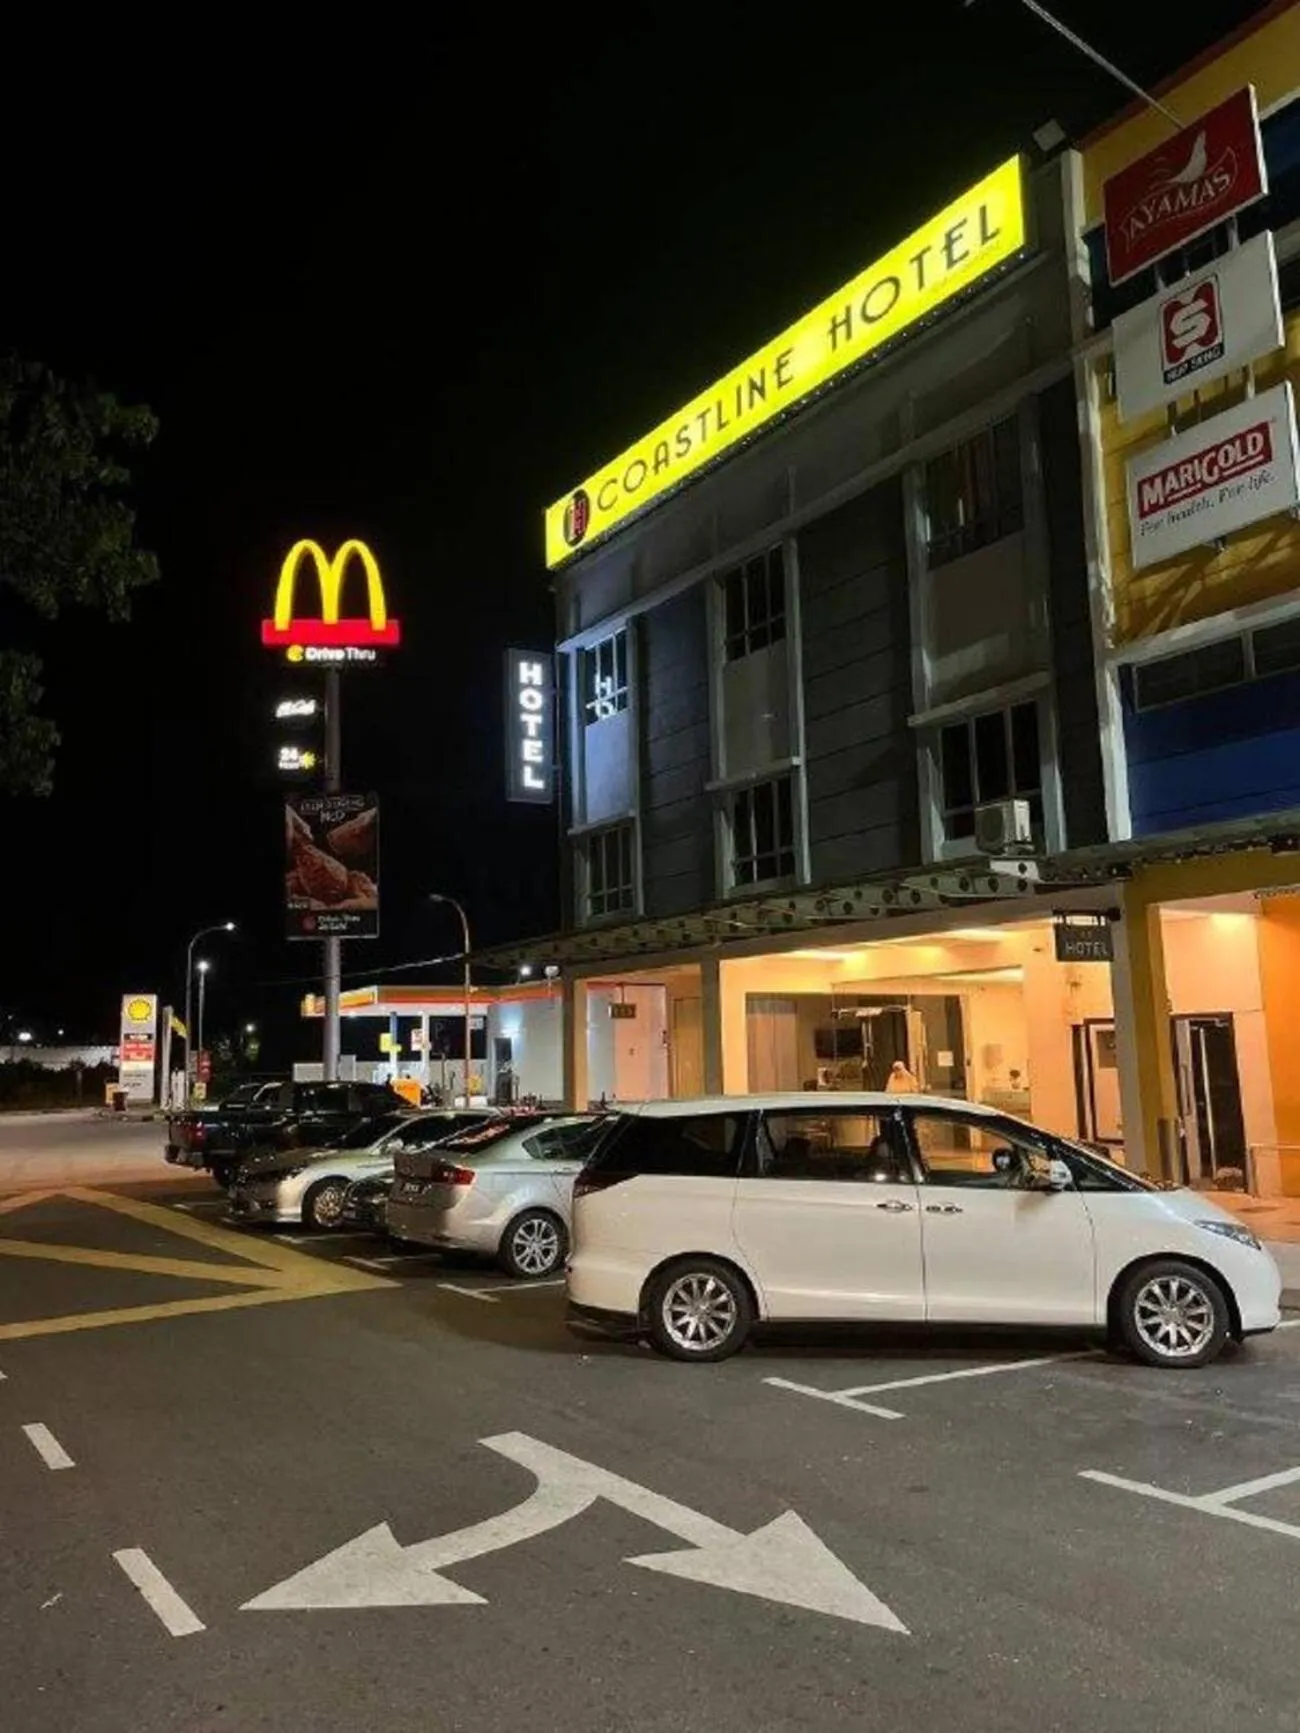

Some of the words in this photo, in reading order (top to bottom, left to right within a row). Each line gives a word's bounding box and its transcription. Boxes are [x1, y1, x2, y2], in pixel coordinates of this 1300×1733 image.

[1130, 167, 1232, 239] AYAMAS
[596, 347, 794, 512] COASTLINE
[827, 203, 1001, 353] HOTEL
[1141, 431, 1265, 512] MARIGOLD
[1219, 486, 1246, 503] For
[304, 646, 345, 661] Drive
[345, 646, 376, 661] Thru
[518, 661, 545, 790] HOTEL
[1065, 942, 1108, 955] HOTEL
